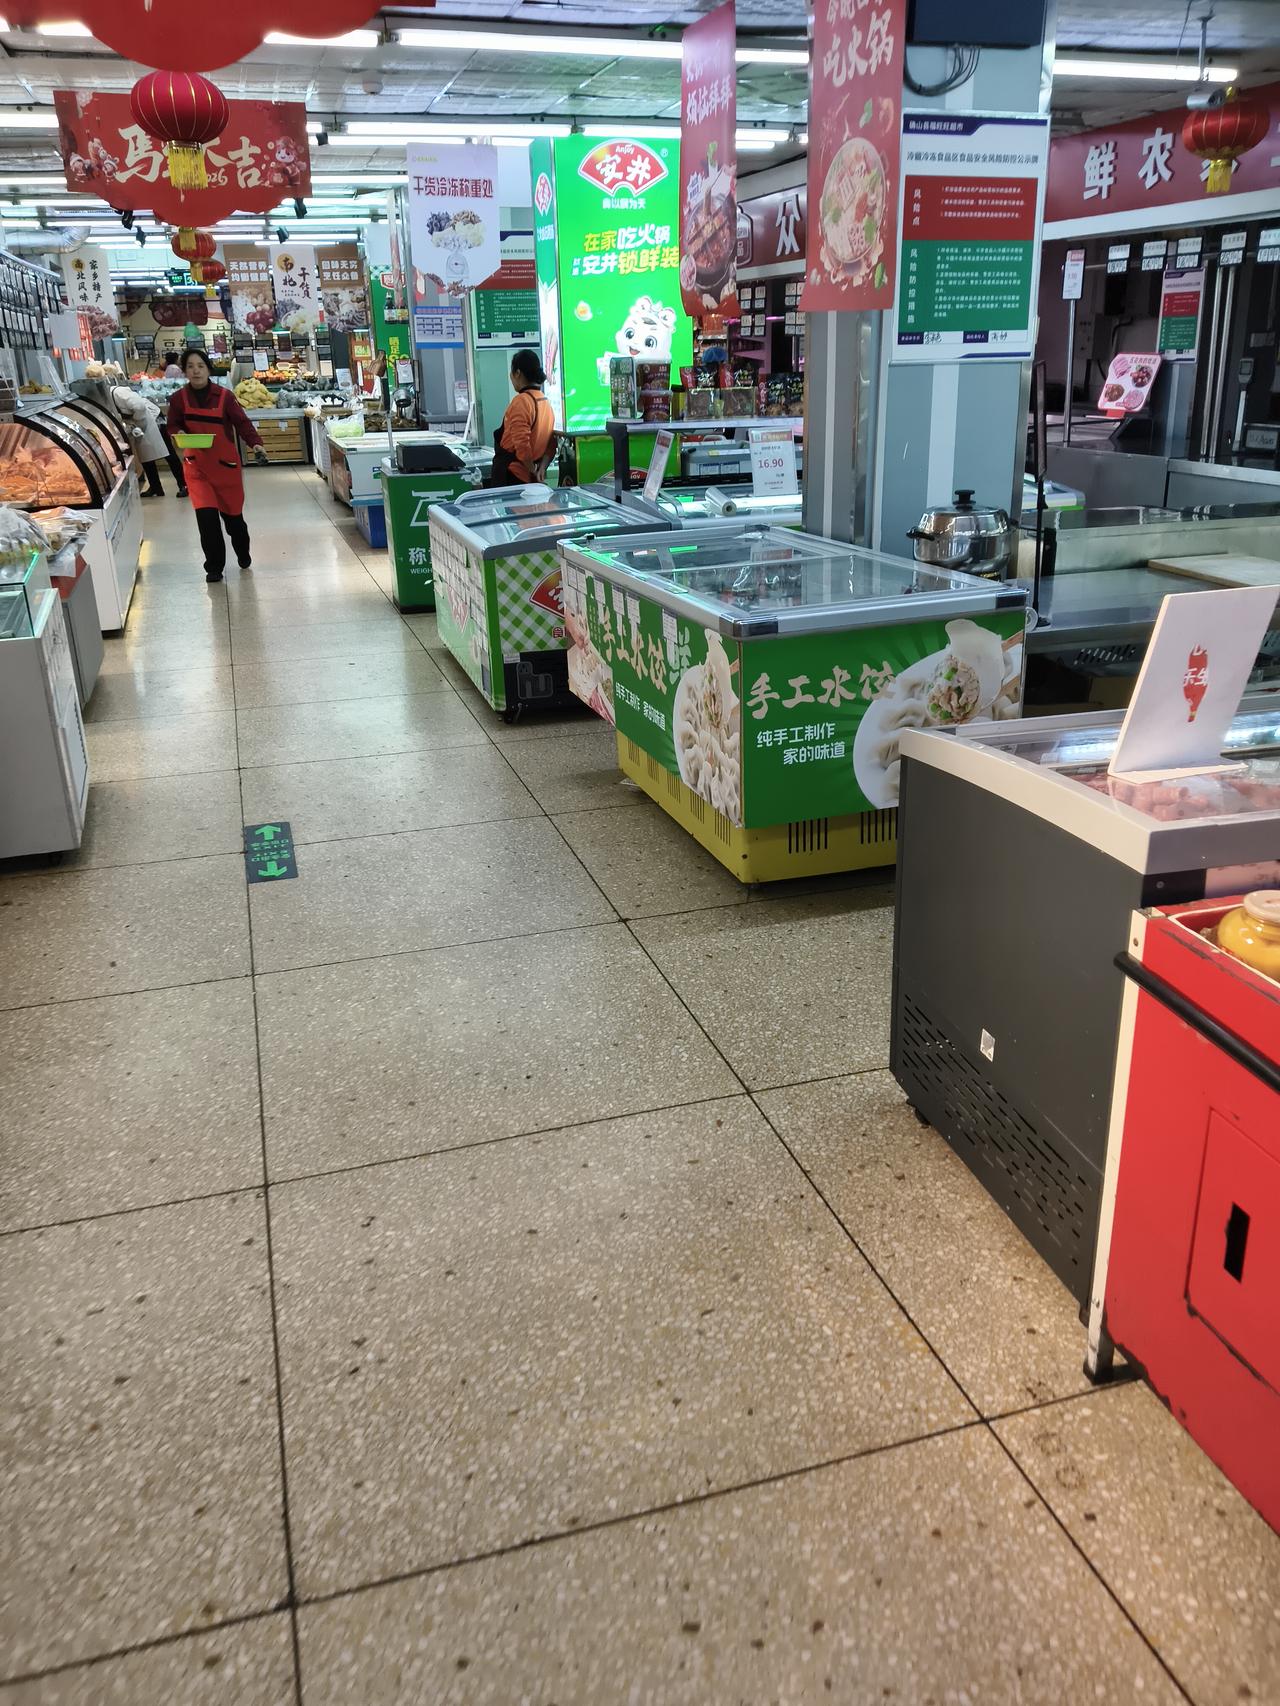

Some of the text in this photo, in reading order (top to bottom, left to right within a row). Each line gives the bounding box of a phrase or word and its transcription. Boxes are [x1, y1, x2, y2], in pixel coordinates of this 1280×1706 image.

[823, 9, 894, 87] 吃火锅
[596, 154, 651, 185] 安井
[413, 176, 494, 198] 干货冷冻称重处
[584, 223, 671, 252] 在家吃火锅
[758, 458, 784, 469] 16.90
[408, 546, 432, 566] 称
[746, 660, 899, 719] 手工水饺
[615, 681, 666, 731] 纯手工制作 家的味道
[756, 721, 836, 749] 纯手工制作
[783, 741, 846, 766] 家的味道
